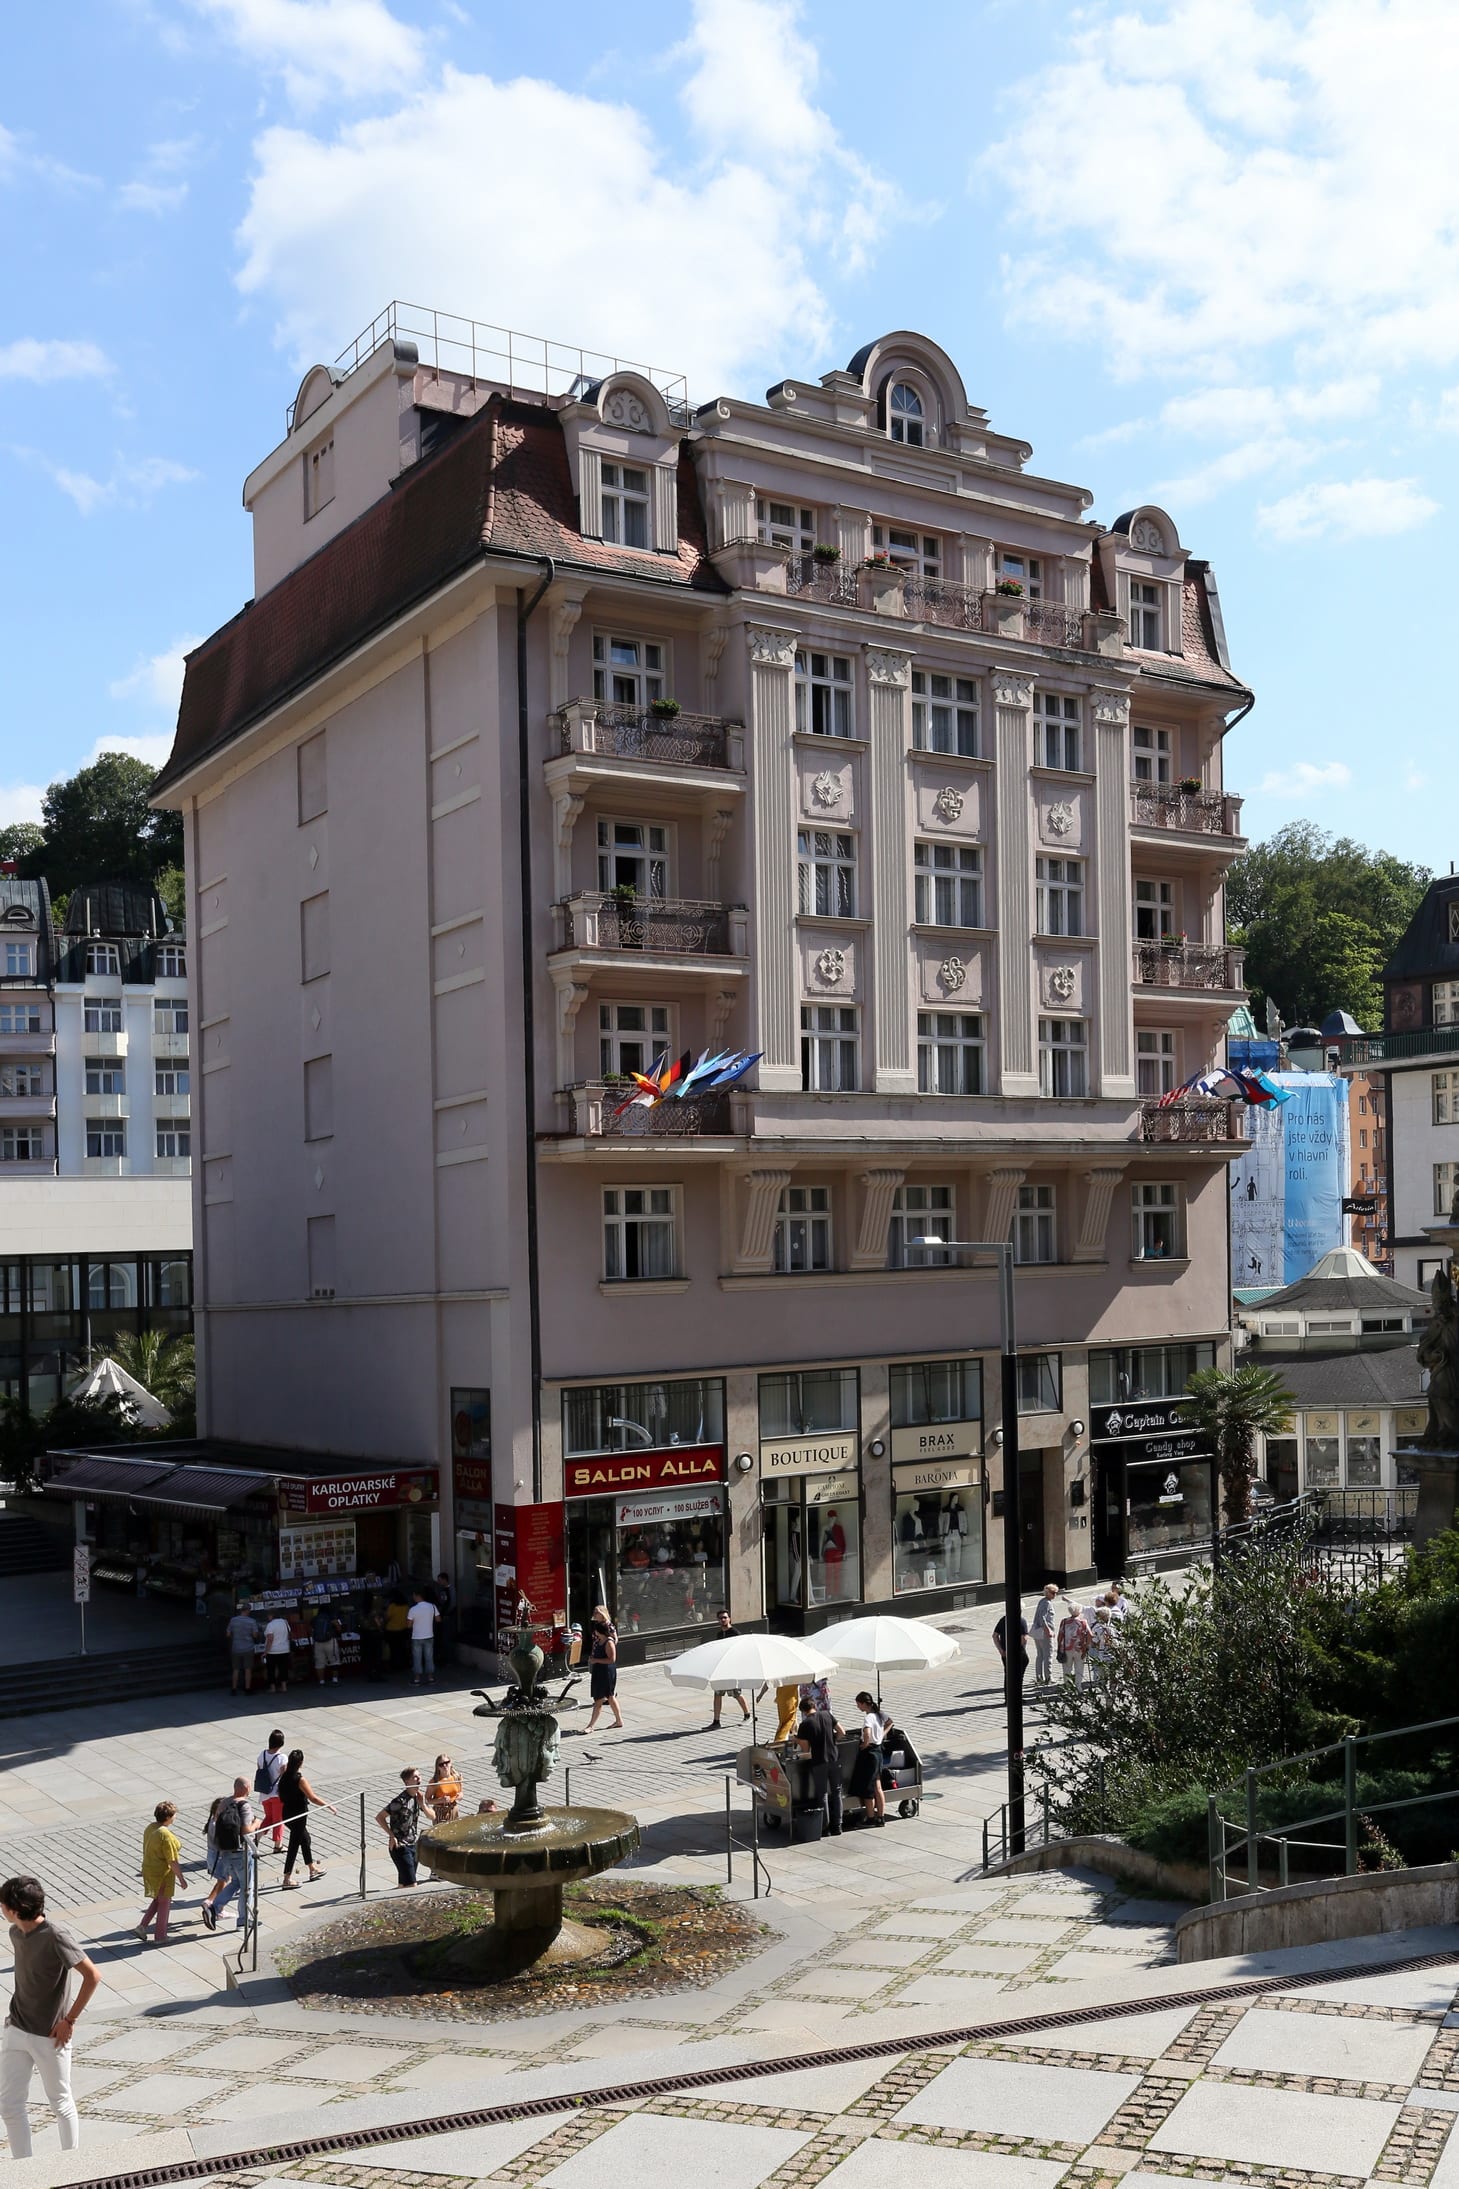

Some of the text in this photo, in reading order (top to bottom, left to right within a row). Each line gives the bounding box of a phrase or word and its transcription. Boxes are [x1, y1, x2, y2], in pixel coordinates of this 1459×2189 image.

[1287, 1112, 1325, 1125] Pro nás
[1288, 1130, 1332, 1146] jste vždy
[1289, 1148, 1329, 1161] v hlavní
[1289, 1167, 1308, 1180] roli.
[1125, 1414, 1165, 1431] Captain
[920, 1433, 954, 1447] BRAX
[771, 1446, 848, 1466] BOUTIQUE
[456, 1463, 487, 1480] SALON
[574, 1459, 717, 1485] SALON ALLA
[915, 1471, 958, 1484] BARONIA
[312, 1475, 396, 1496] KARLOVARSKÉ
[328, 1492, 381, 1508] OPLATKY
[633, 1509, 643, 1518] 100
[674, 1503, 685, 1513] 100
